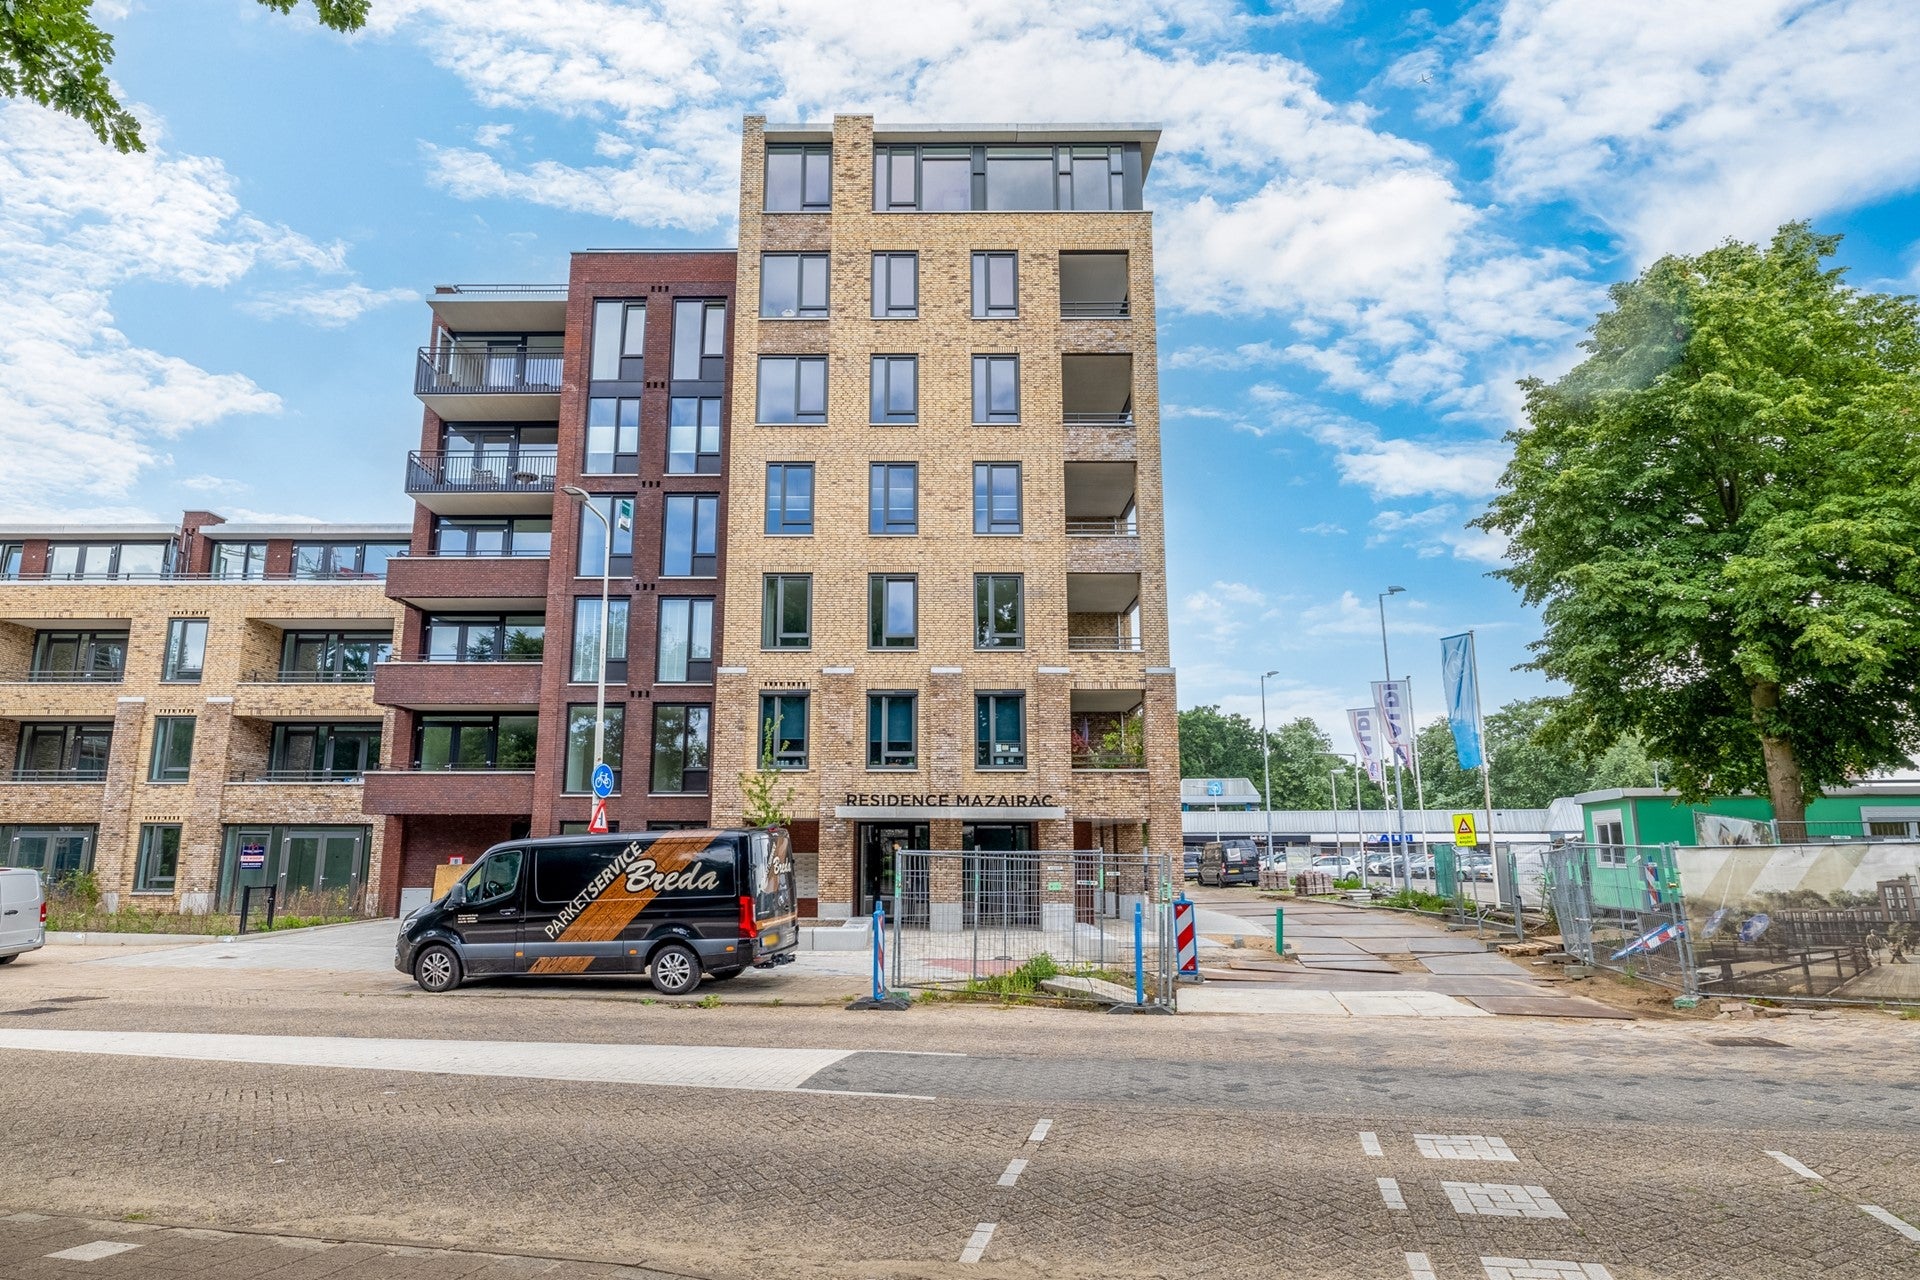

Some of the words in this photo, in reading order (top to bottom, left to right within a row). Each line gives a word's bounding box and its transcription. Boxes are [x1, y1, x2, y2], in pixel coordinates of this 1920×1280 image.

[846, 794, 949, 807] RESIDENCE
[956, 794, 1054, 807] MAZAIRAC
[544, 841, 642, 940] PARKETSERVICE
[625, 858, 720, 892] Breda
